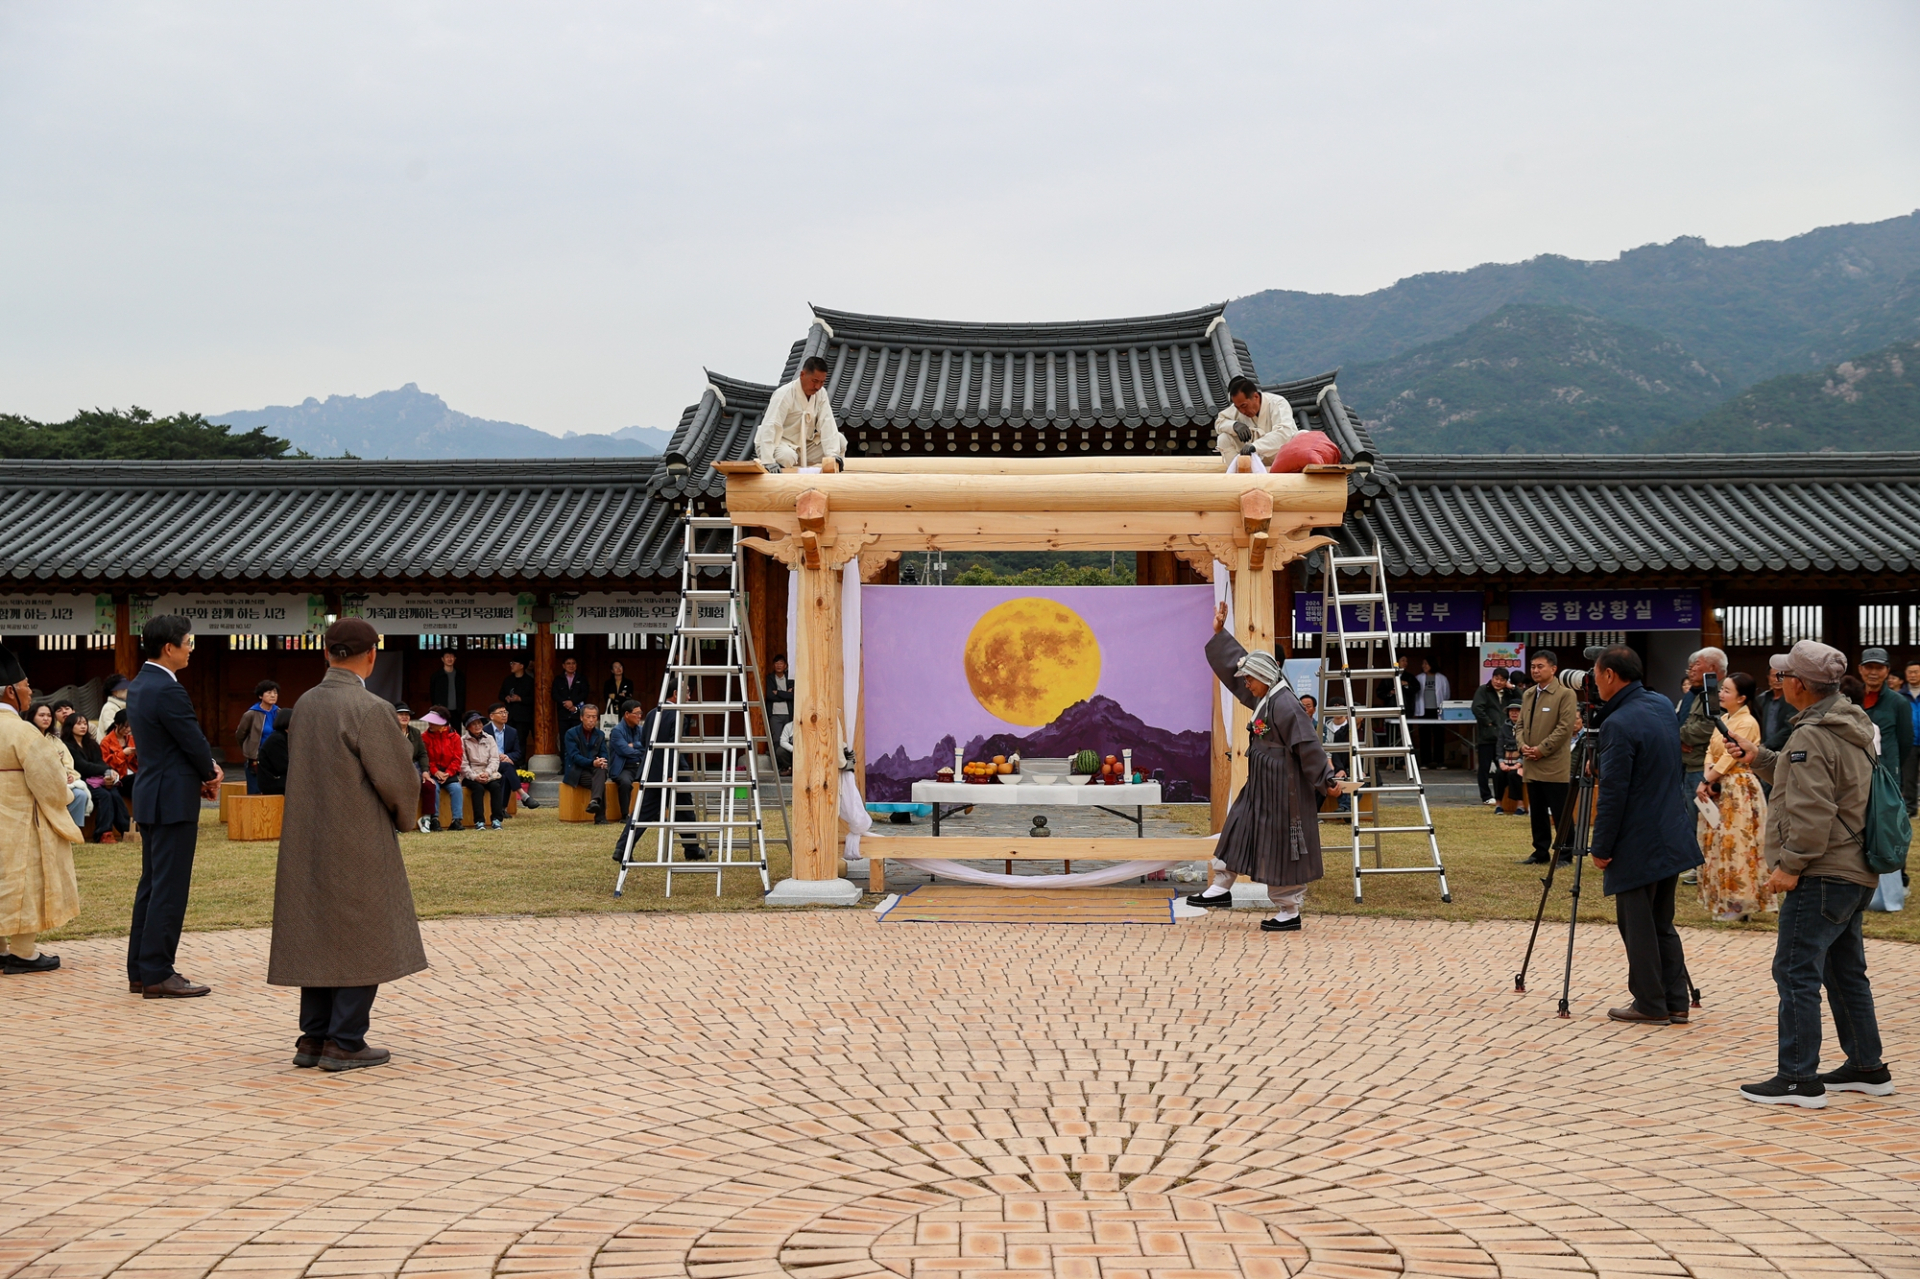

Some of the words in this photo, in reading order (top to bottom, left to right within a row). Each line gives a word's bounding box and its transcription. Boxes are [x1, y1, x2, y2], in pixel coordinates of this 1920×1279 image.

[24, 608, 47, 620] 하는
[50, 608, 74, 620] 시간
[211, 607, 234, 619] 함께
[237, 607, 260, 619] 하는
[263, 607, 286, 619] 시간
[366, 607, 397, 620] 가족과
[399, 607, 440, 620] 함께하는
[440, 607, 471, 620] 우드리
[473, 607, 514, 620] 목공체험
[577, 606, 608, 619] 가족과
[609, 606, 650, 618] 함께하는
[1539, 600, 1652, 621] 종합상황실
